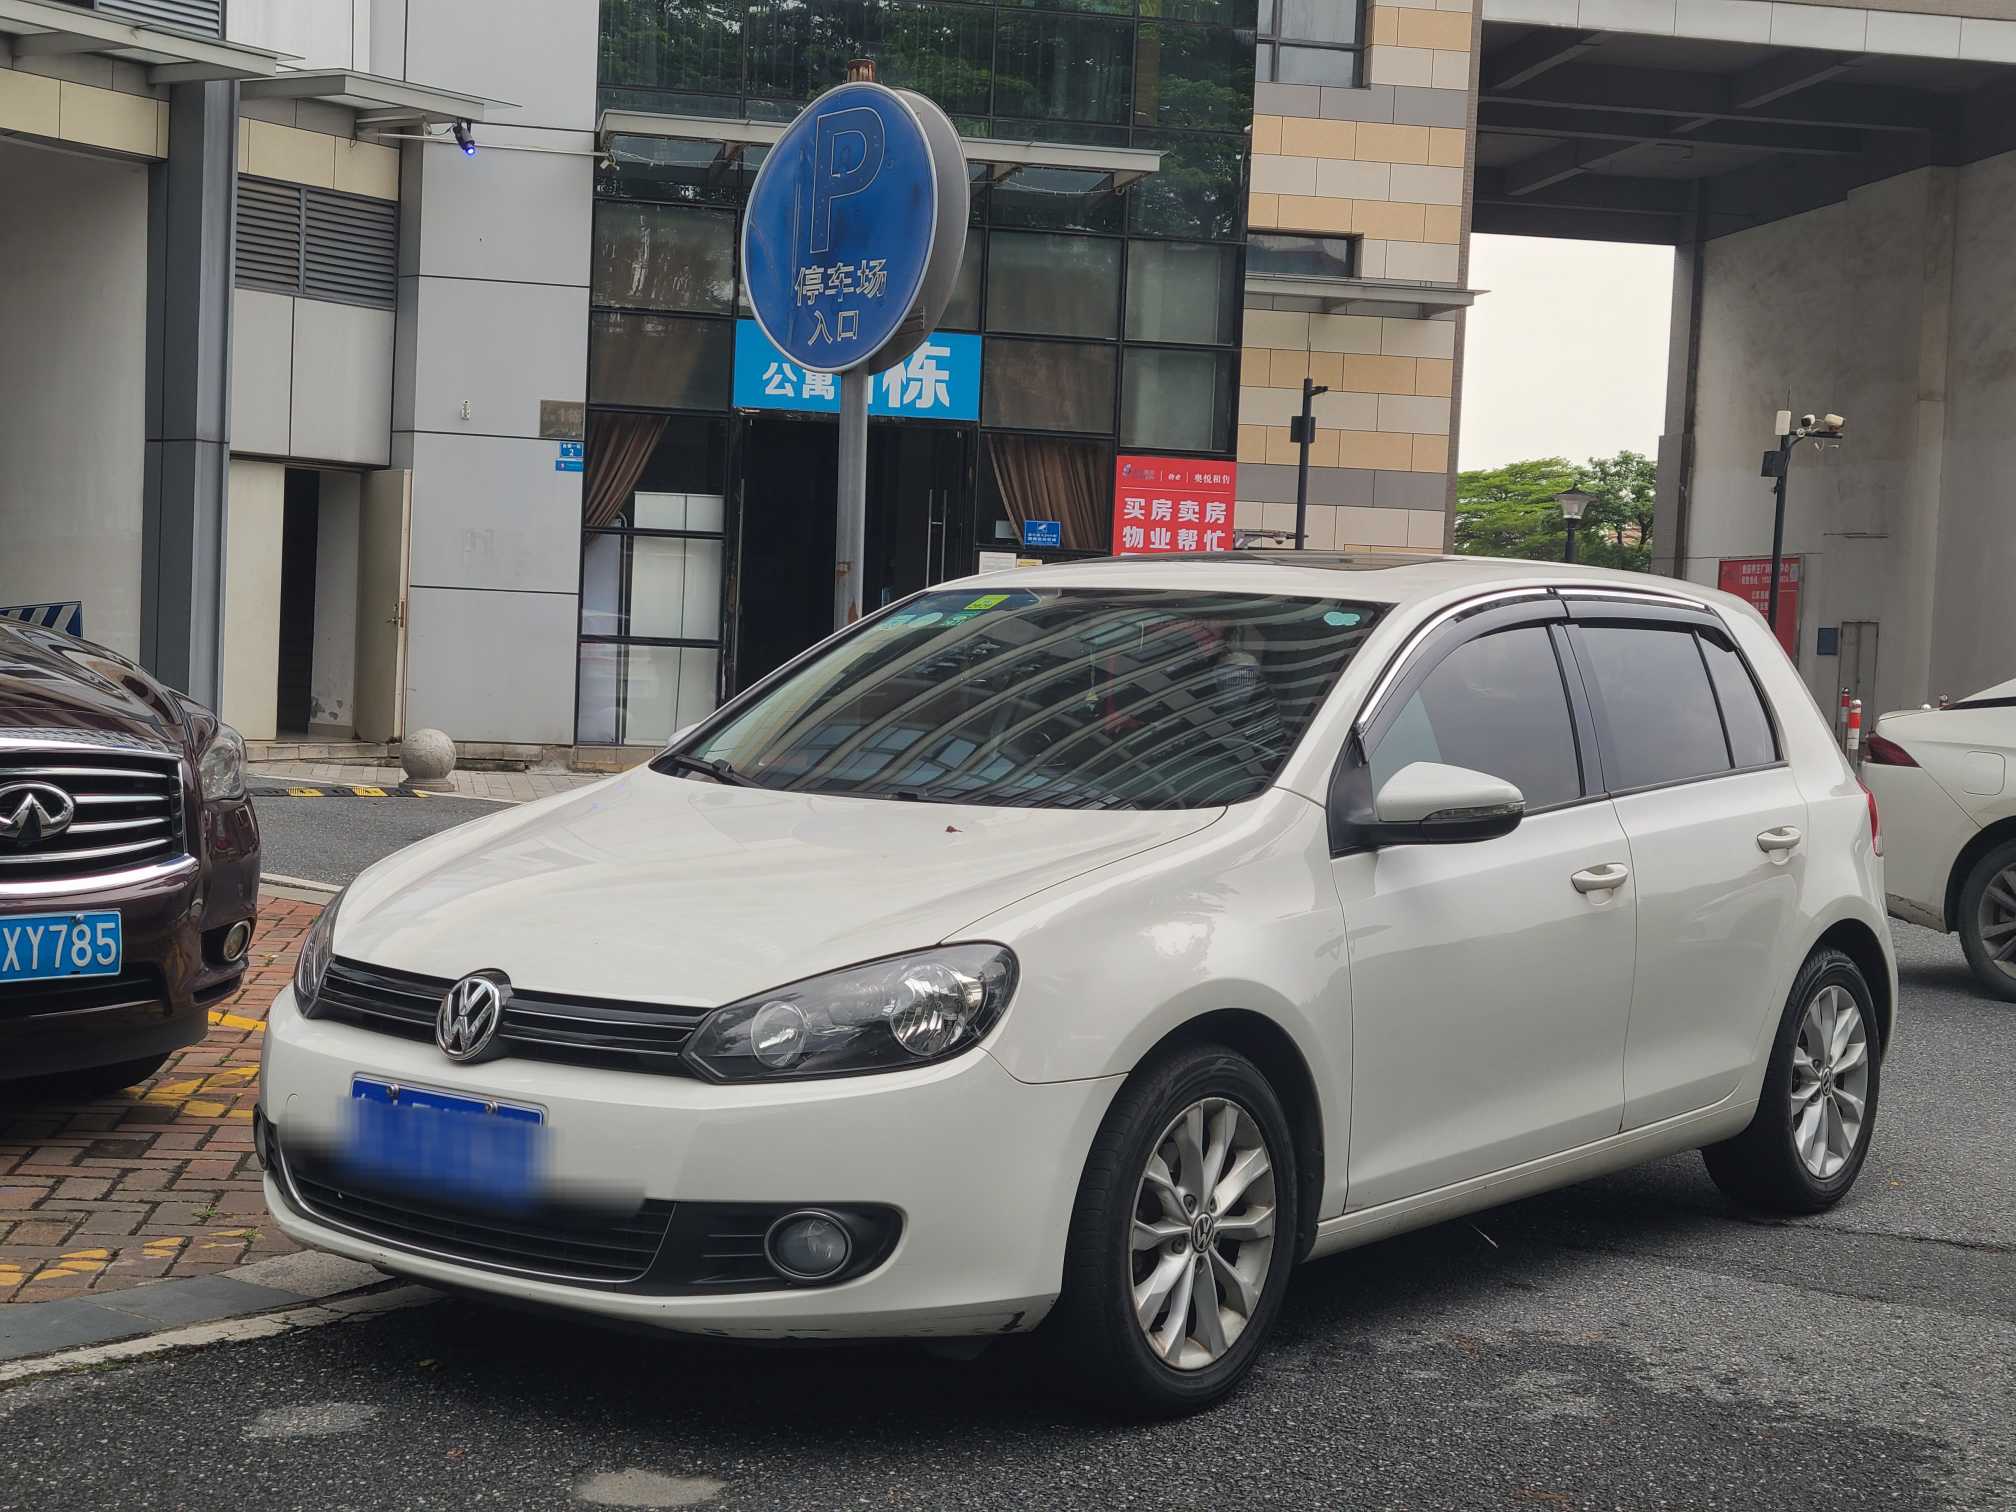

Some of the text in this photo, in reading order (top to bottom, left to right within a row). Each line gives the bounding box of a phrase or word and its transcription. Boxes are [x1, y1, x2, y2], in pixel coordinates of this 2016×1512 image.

[809, 107, 885, 253] P
[795, 259, 888, 306] 停车场
[808, 310, 859, 345] 入口
[762, 341, 951, 409] 公寓栋
[1123, 497, 1227, 524] 买房卖房
[1122, 525, 1226, 552] 物业帮忙
[2, 922, 117, 972] XY785
